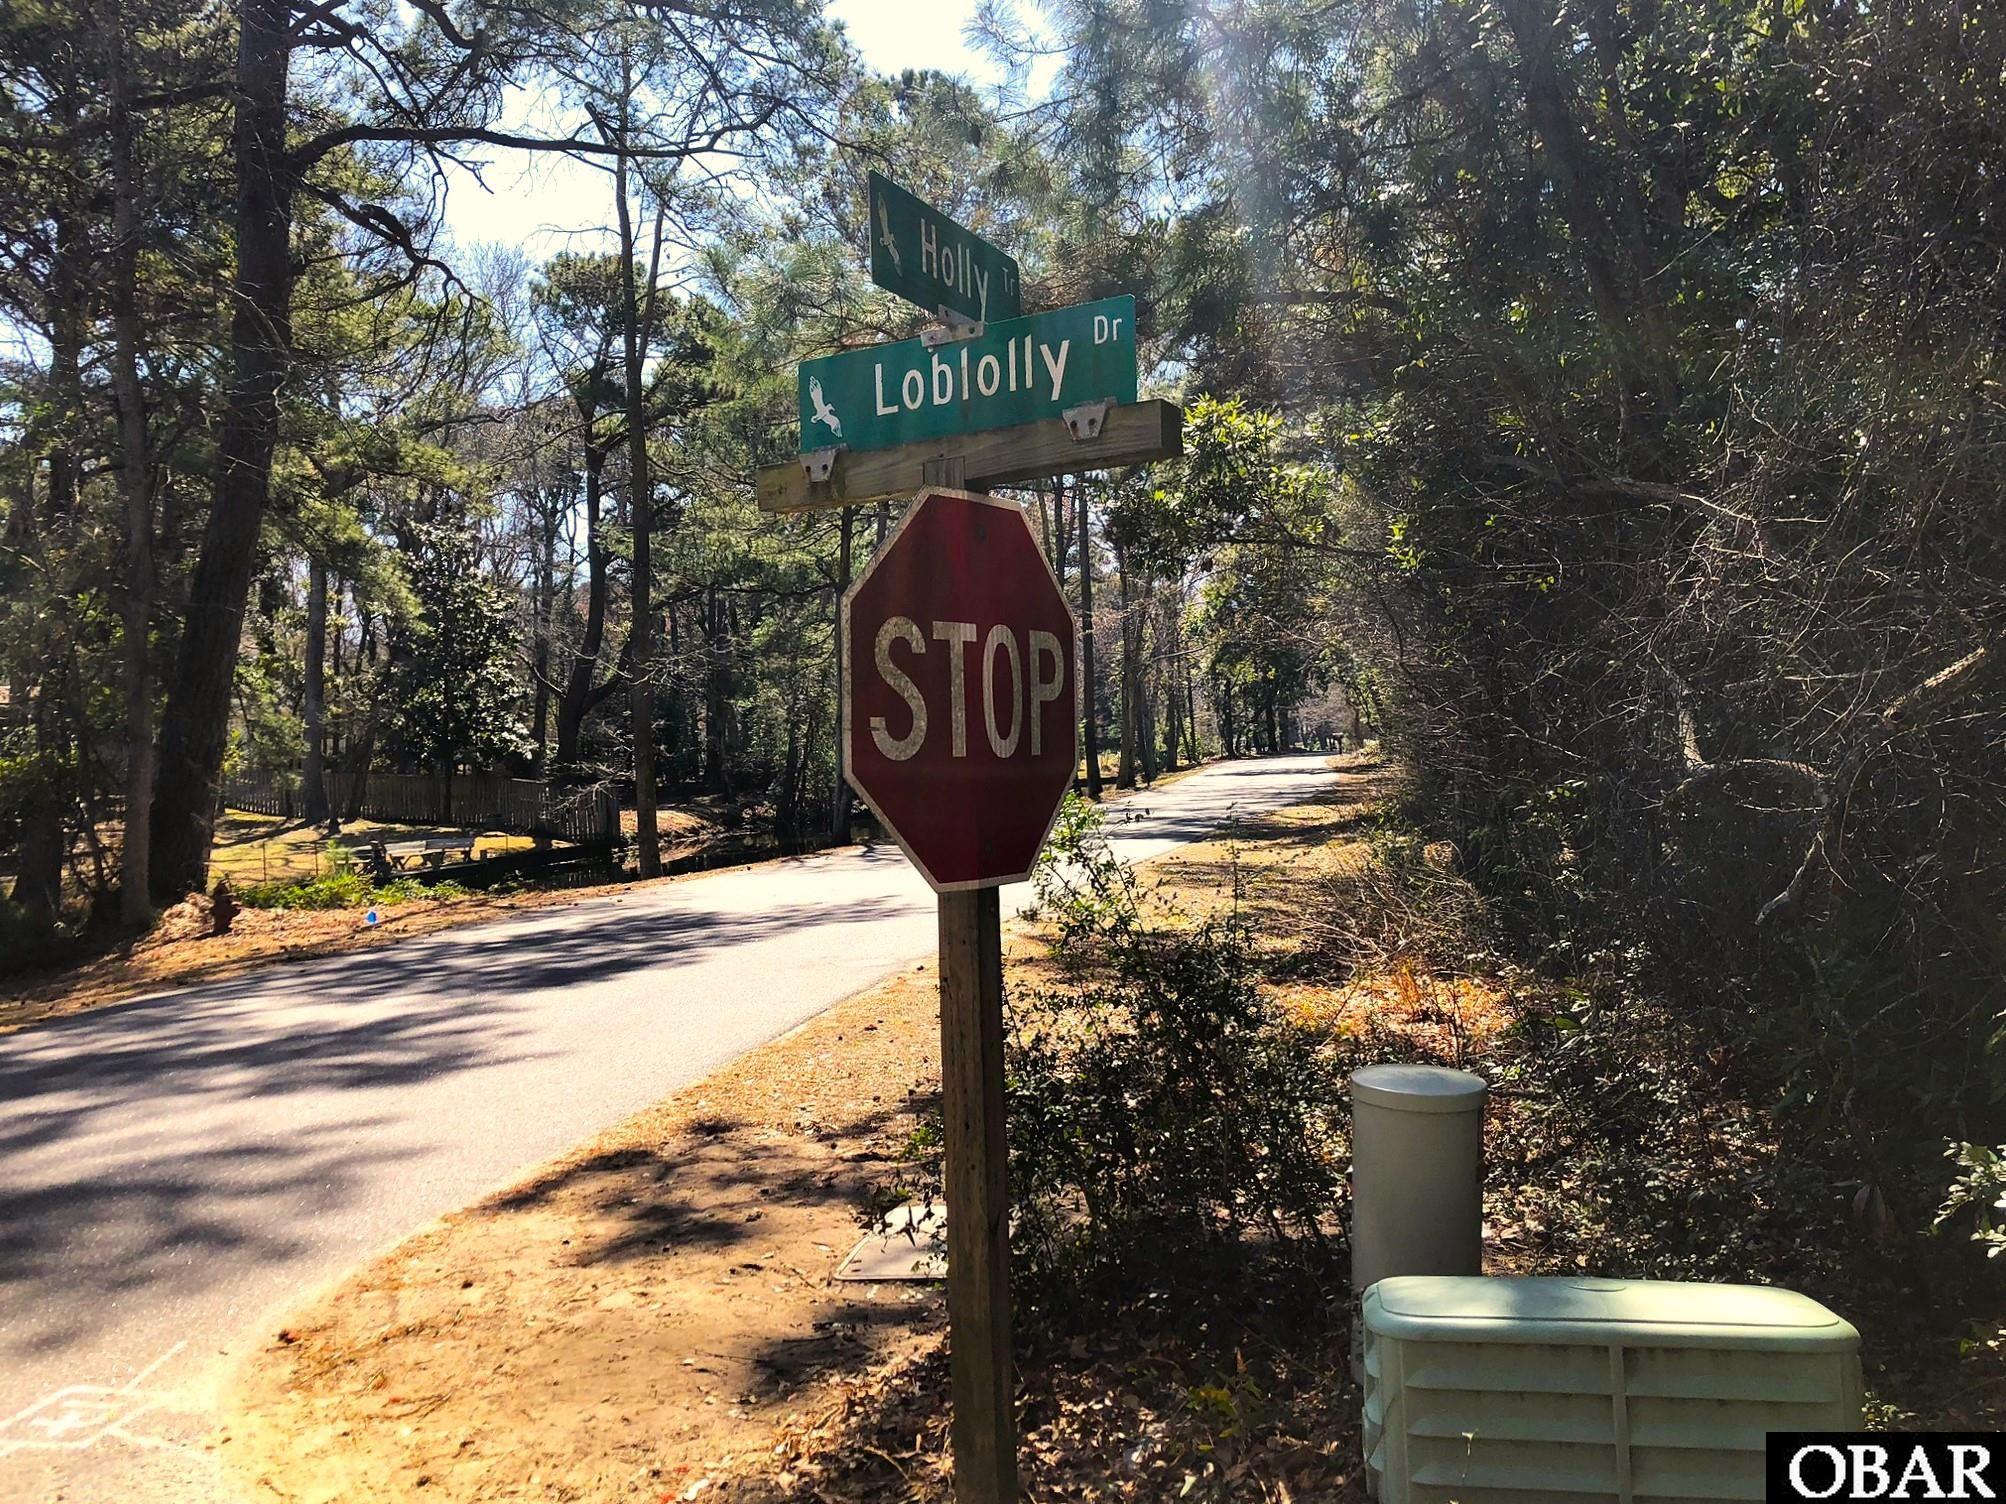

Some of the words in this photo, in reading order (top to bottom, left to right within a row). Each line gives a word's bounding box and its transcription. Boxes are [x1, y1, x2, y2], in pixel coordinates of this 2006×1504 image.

[920, 217, 989, 322] Holly
[1001, 266, 1015, 297] Tr
[874, 333, 1070, 417] Loblolly
[1093, 314, 1123, 345] Dr
[869, 615, 1065, 762] STOP
